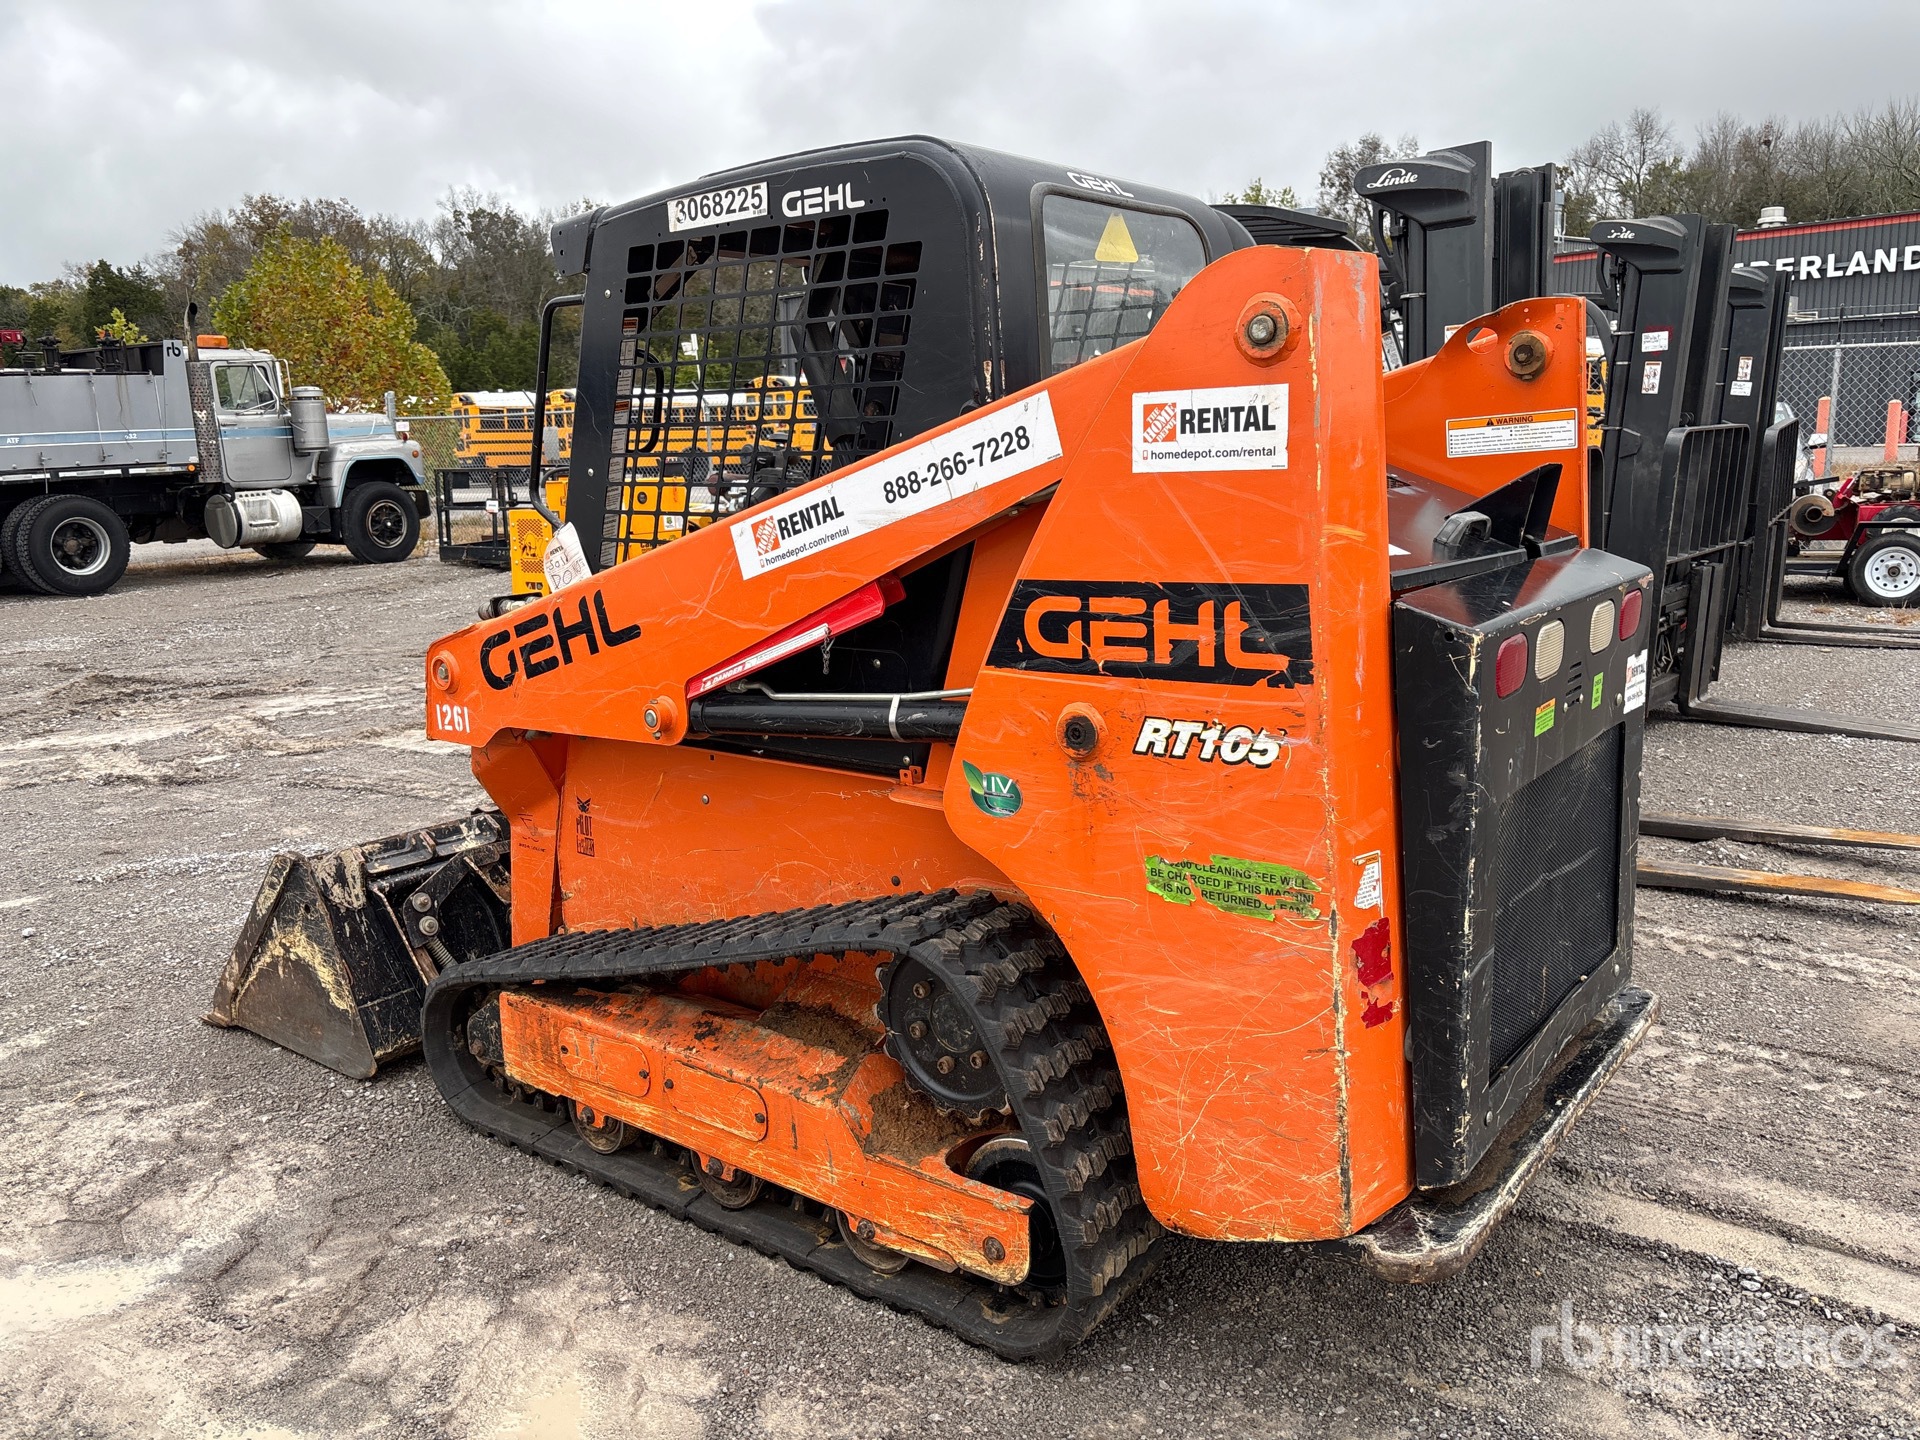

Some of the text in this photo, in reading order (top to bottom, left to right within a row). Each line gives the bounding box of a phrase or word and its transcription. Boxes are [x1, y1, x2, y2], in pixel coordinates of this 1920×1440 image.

[1066, 171, 1134, 197] GEHL
[1366, 168, 1418, 189] Linde
[675, 185, 763, 224] 3068225
[781, 182, 865, 218] GEHL
[166, 342, 182, 357] rb
[1143, 402, 1177, 443] HOME
[1146, 406, 1161, 423] THE
[1180, 404, 1276, 434] RENTAL
[1496, 415, 1534, 425] WARNING
[882, 425, 1031, 504] 888-266-7228
[1150, 446, 1276, 461] homedepot.com/rental
[776, 496, 845, 540] RENTAL
[765, 526, 850, 566] homedepot.com/rental
[479, 589, 642, 691] GEHL
[1024, 595, 1290, 671] GEHL
[436, 704, 470, 733] 1261
[1132, 716, 1284, 769] RT105
[1150, 867, 1164, 878] BE
[1167, 870, 1221, 888] CHARGED
[1223, 880, 1233, 890] IF
[1236, 881, 1262, 895] THIS
[1195, 863, 1252, 880] CLEANING
[1163, 882, 1173, 892] IS
[1201, 889, 1262, 909] RETURNED
